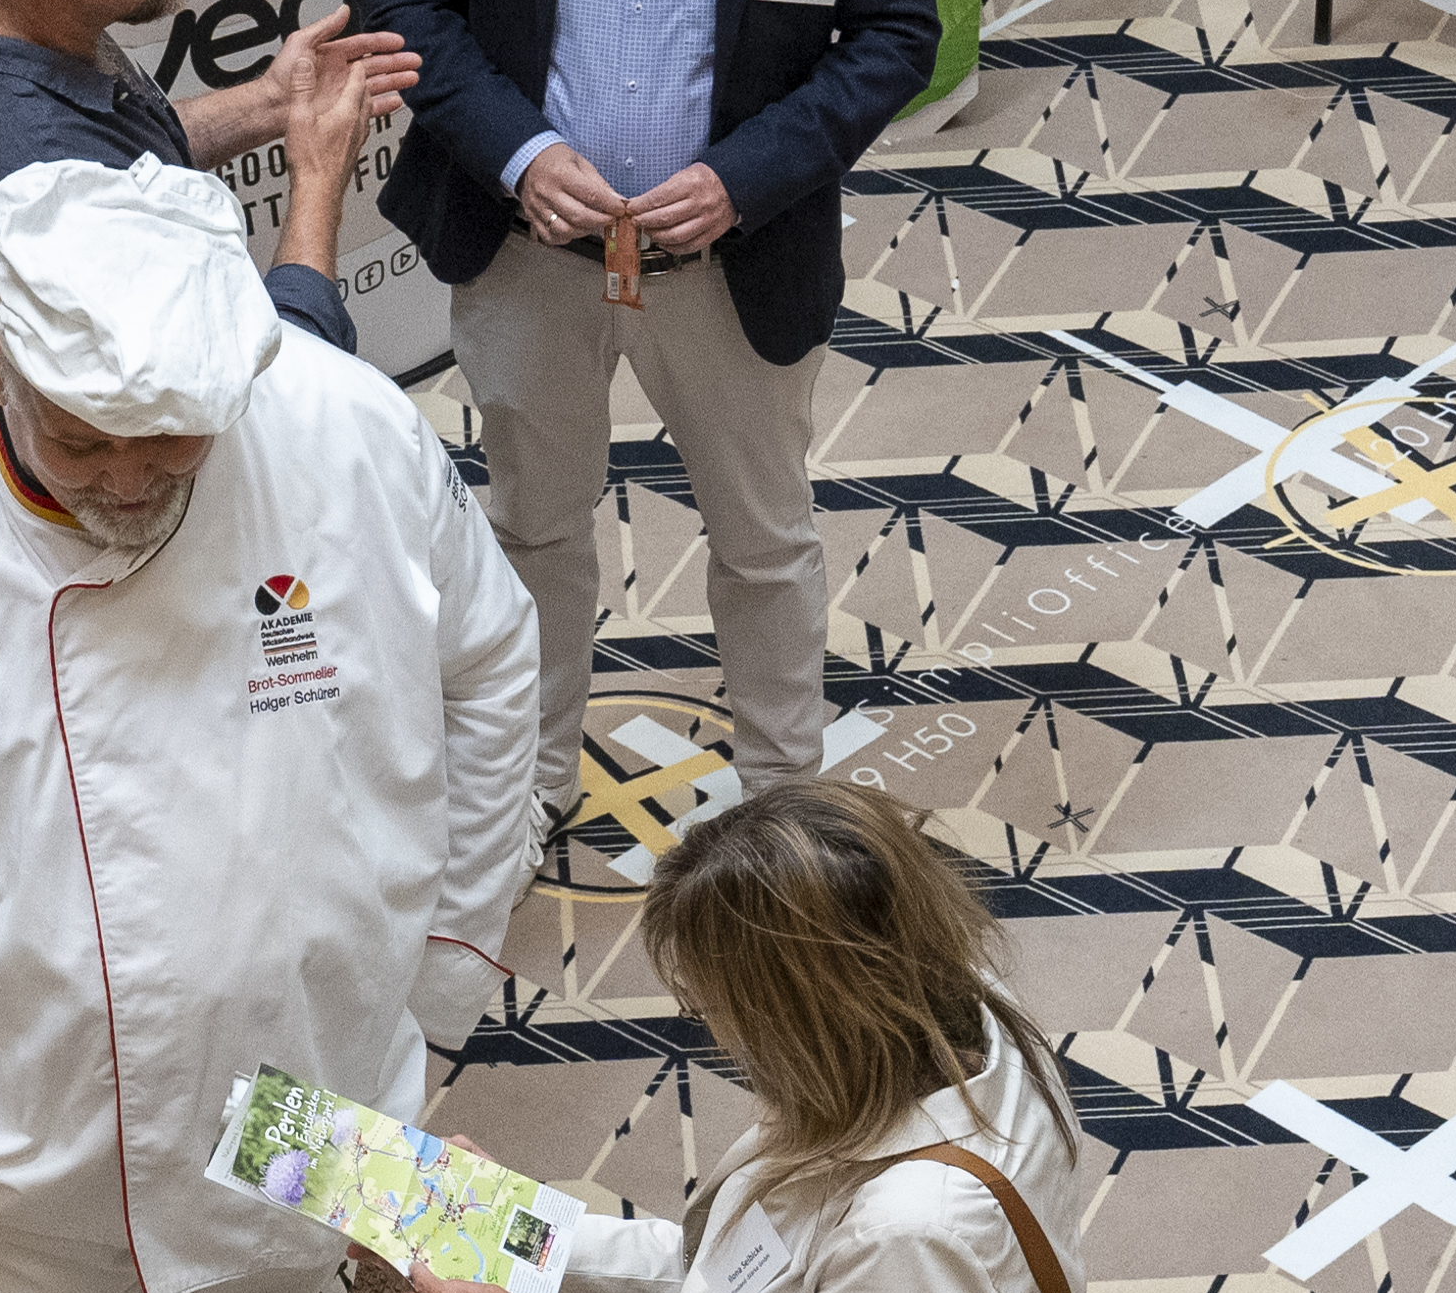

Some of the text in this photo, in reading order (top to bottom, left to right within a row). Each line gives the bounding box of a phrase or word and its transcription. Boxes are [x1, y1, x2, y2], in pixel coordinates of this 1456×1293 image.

[260, 612, 314, 631] AKADEMIE
[854, 513, 1196, 727] SimpliOffice
[247, 665, 338, 694] Brot-Sommelier
[265, 649, 319, 667] Weinheim
[249, 686, 341, 715] Holger Schüren
[881, 710, 979, 774] H50
[264, 1086, 305, 1148] Perlen
[295, 1089, 321, 1144] Entdecken
[309, 1097, 336, 1155] Naturpark
